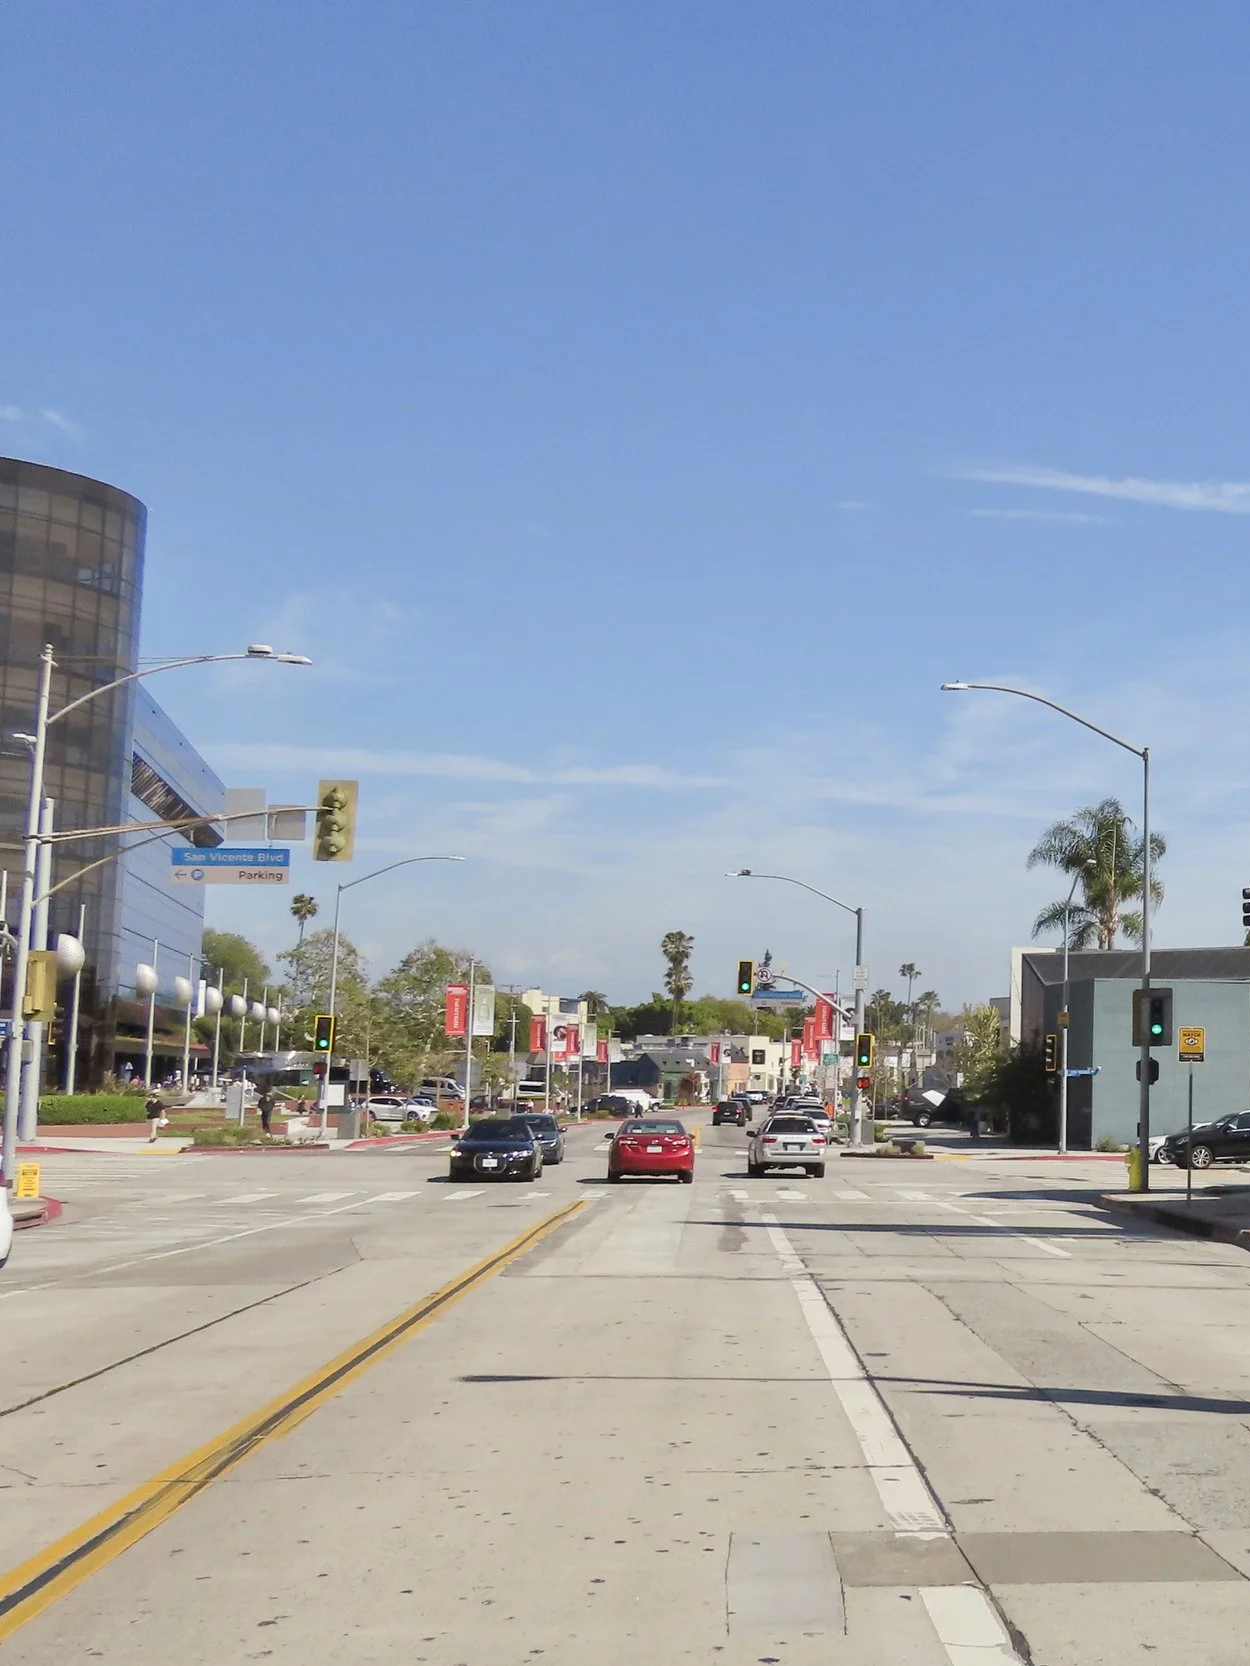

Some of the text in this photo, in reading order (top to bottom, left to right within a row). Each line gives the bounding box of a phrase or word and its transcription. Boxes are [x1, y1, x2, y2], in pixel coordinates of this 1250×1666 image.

[184, 851, 284, 862] San Vicente Blvd
[238, 870, 284, 882] Parking
